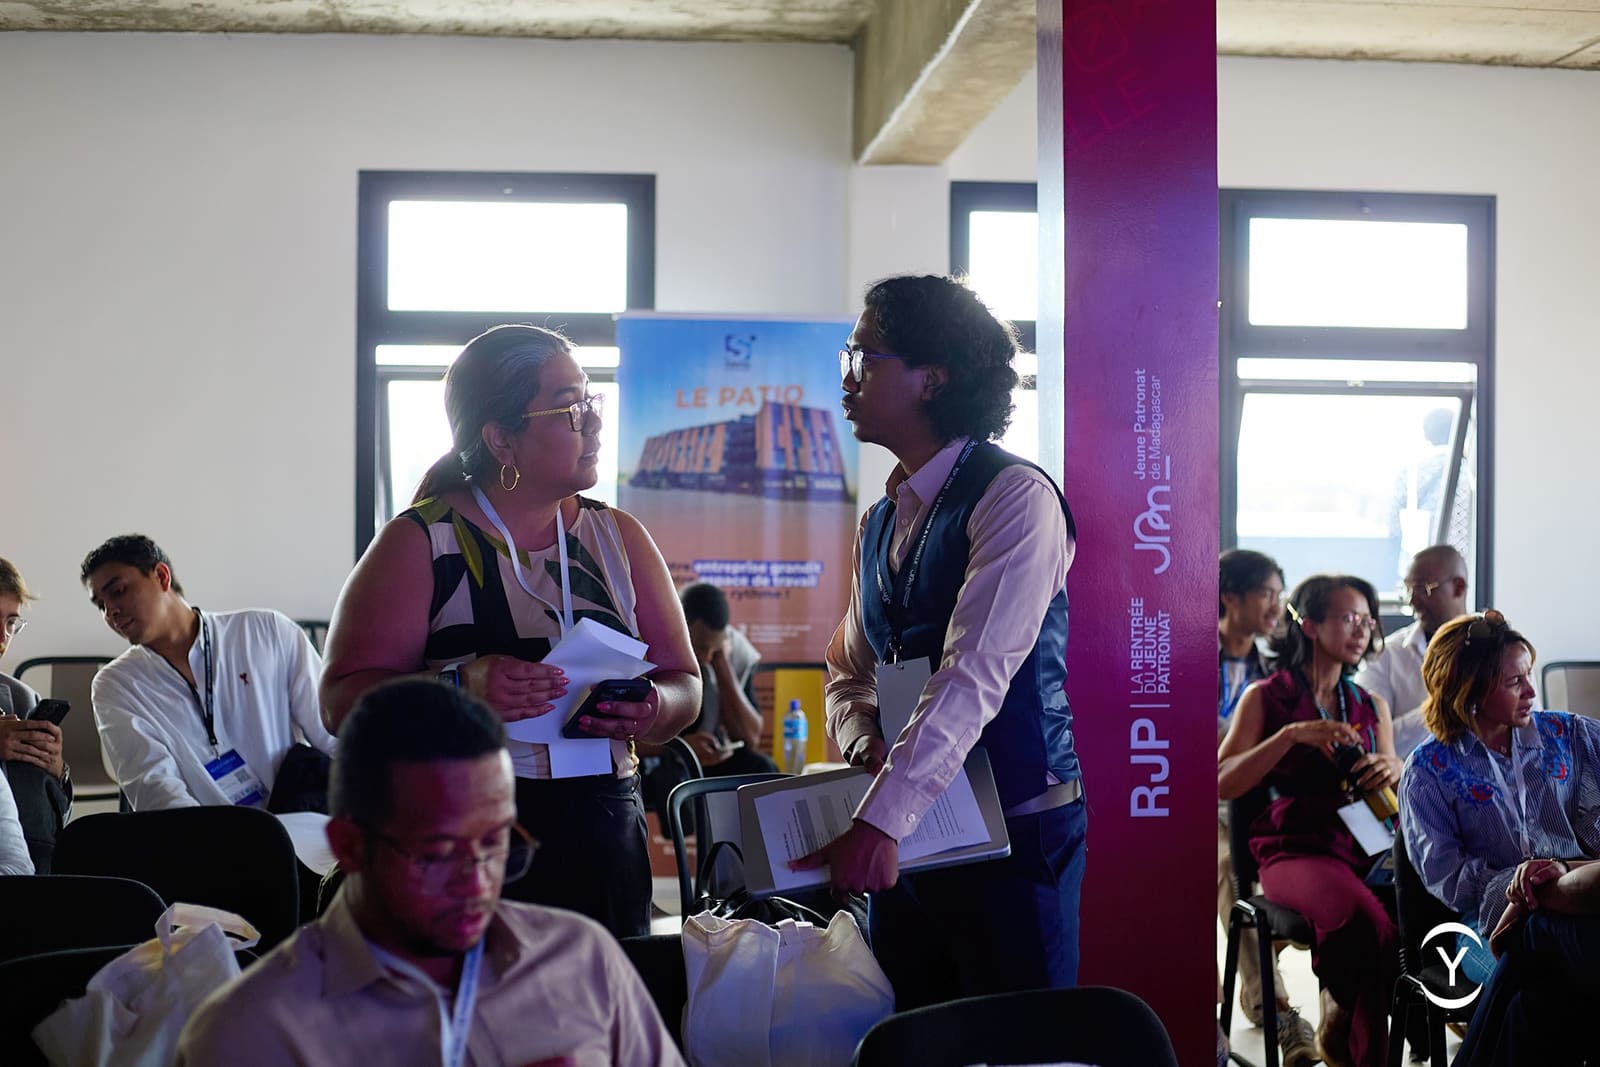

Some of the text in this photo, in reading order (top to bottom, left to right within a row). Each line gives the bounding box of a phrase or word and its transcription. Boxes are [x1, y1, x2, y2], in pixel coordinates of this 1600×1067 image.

[676, 386, 707, 408] LE
[1134, 368, 1146, 480] Jeune Patronat
[1149, 375, 1164, 480] de Madagascar
[1128, 597, 1144, 694] LA RENTRÉE
[1144, 616, 1157, 694] DU JEUNE
[1157, 610, 1170, 694] PATRONAT
[1130, 718, 1170, 817] RJP
